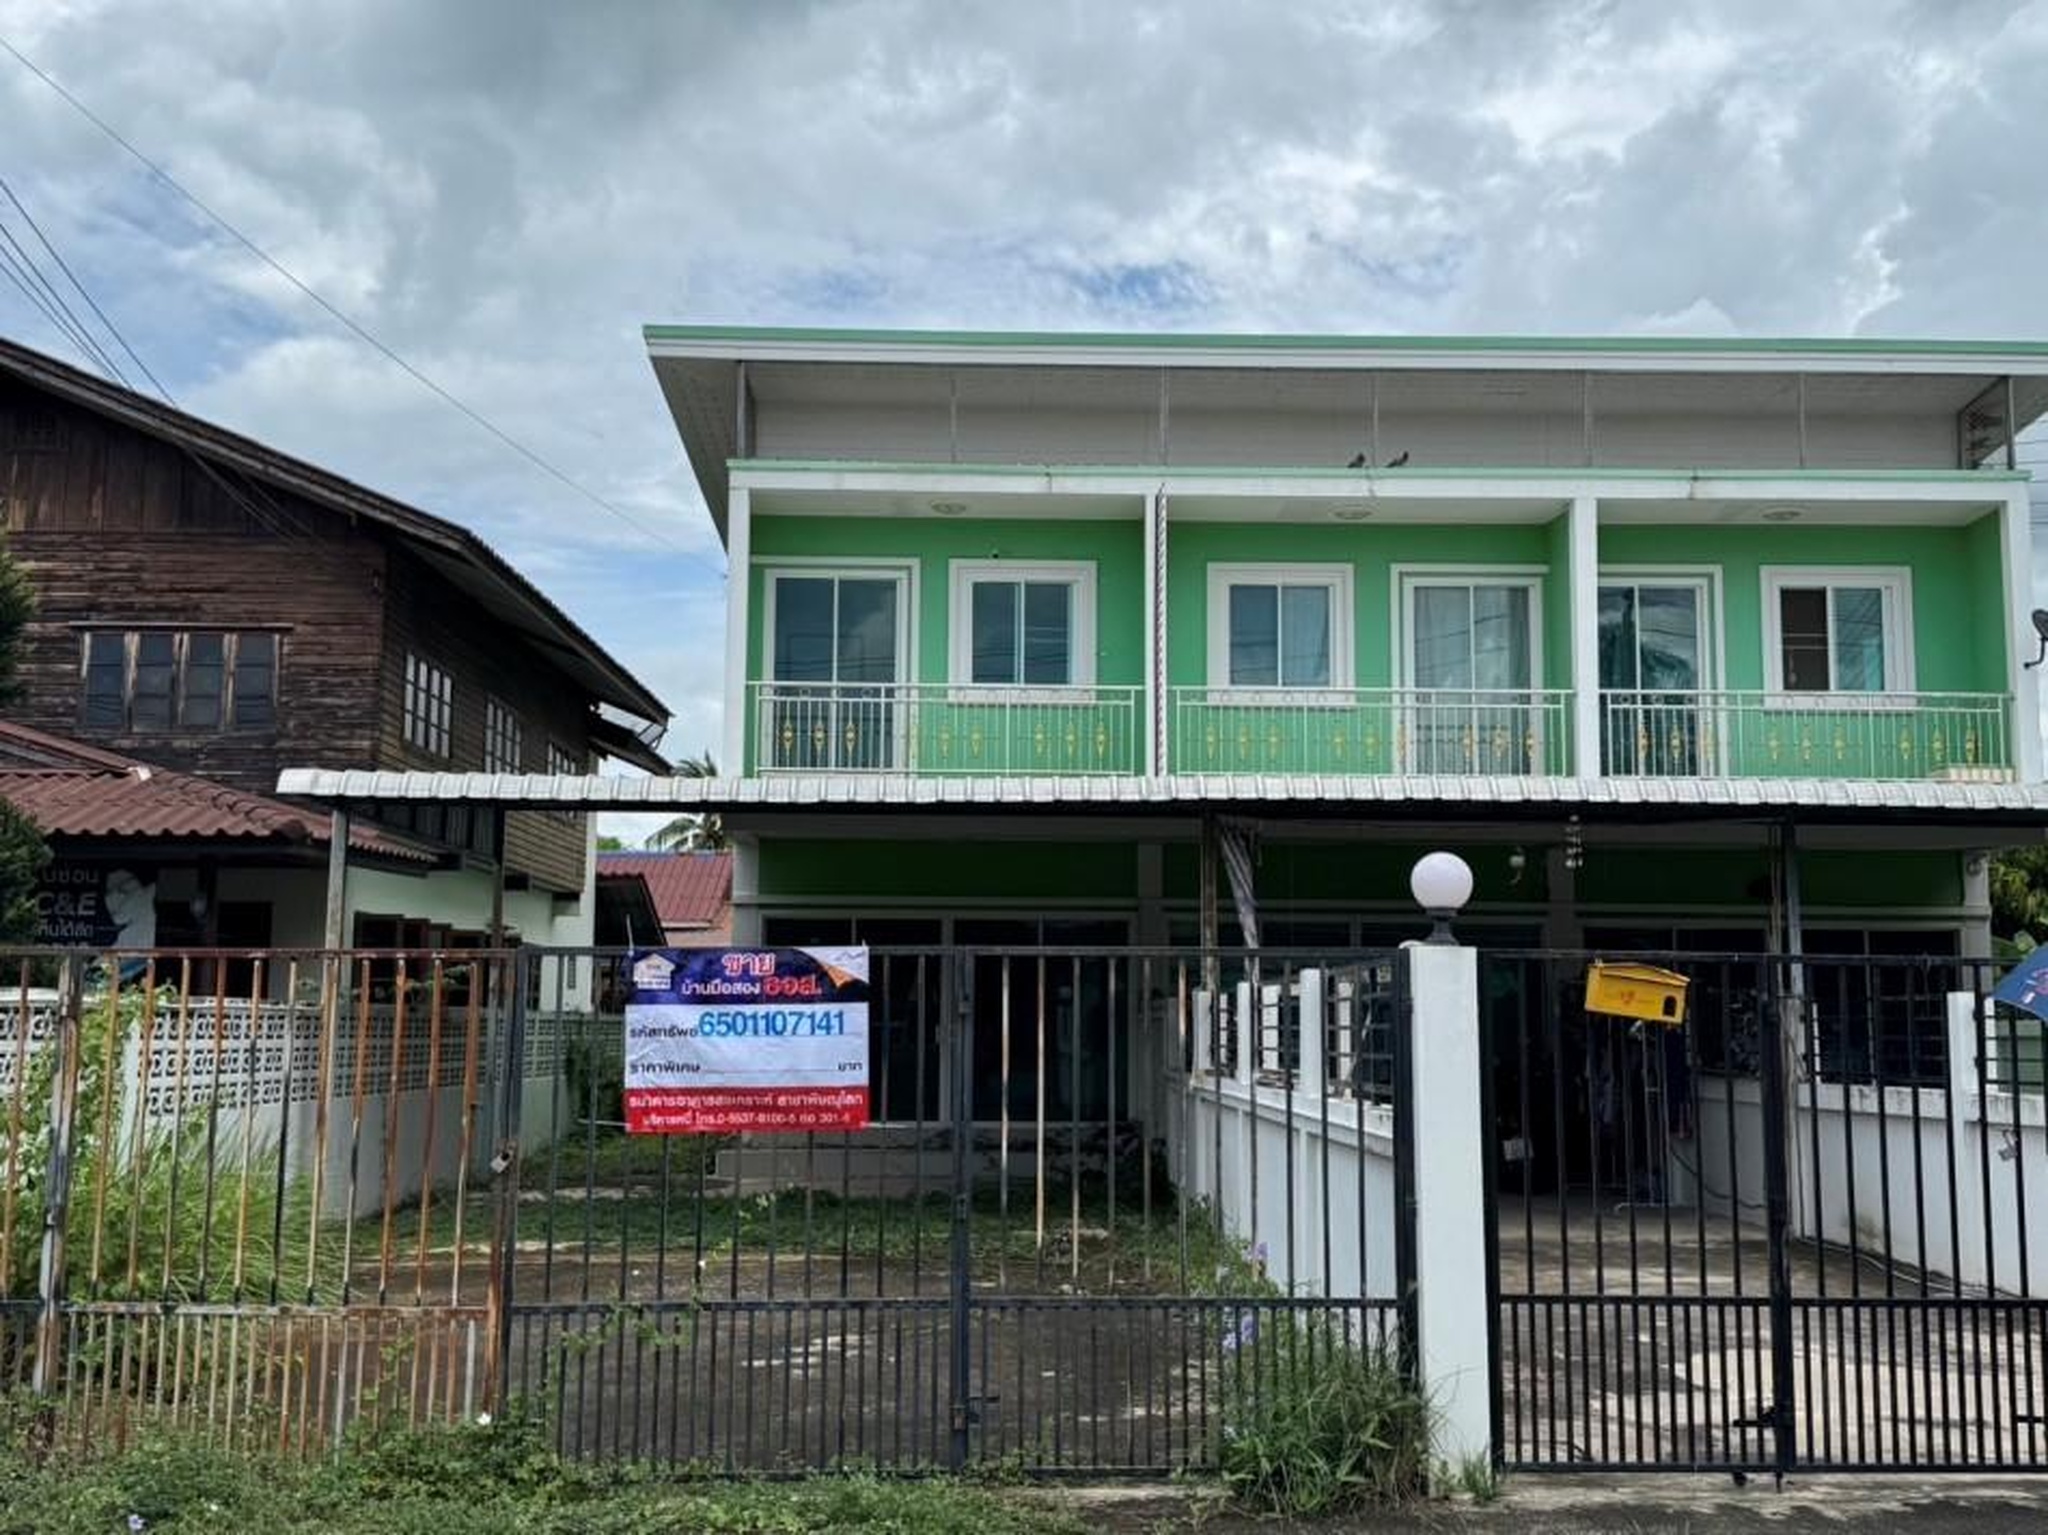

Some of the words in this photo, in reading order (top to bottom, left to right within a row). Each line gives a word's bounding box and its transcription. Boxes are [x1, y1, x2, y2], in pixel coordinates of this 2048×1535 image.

[34, 891, 97, 915] C&E
[722, 953, 776, 976] ขาย
[682, 977, 760, 994] บ้านมือสอง
[699, 1011, 844, 1036] 6501107141
[630, 1060, 700, 1075] ราคาพิเศษ
[838, 1062, 862, 1072] บาท
[777, 1090, 863, 1109] สาขาพิษณุโลก
